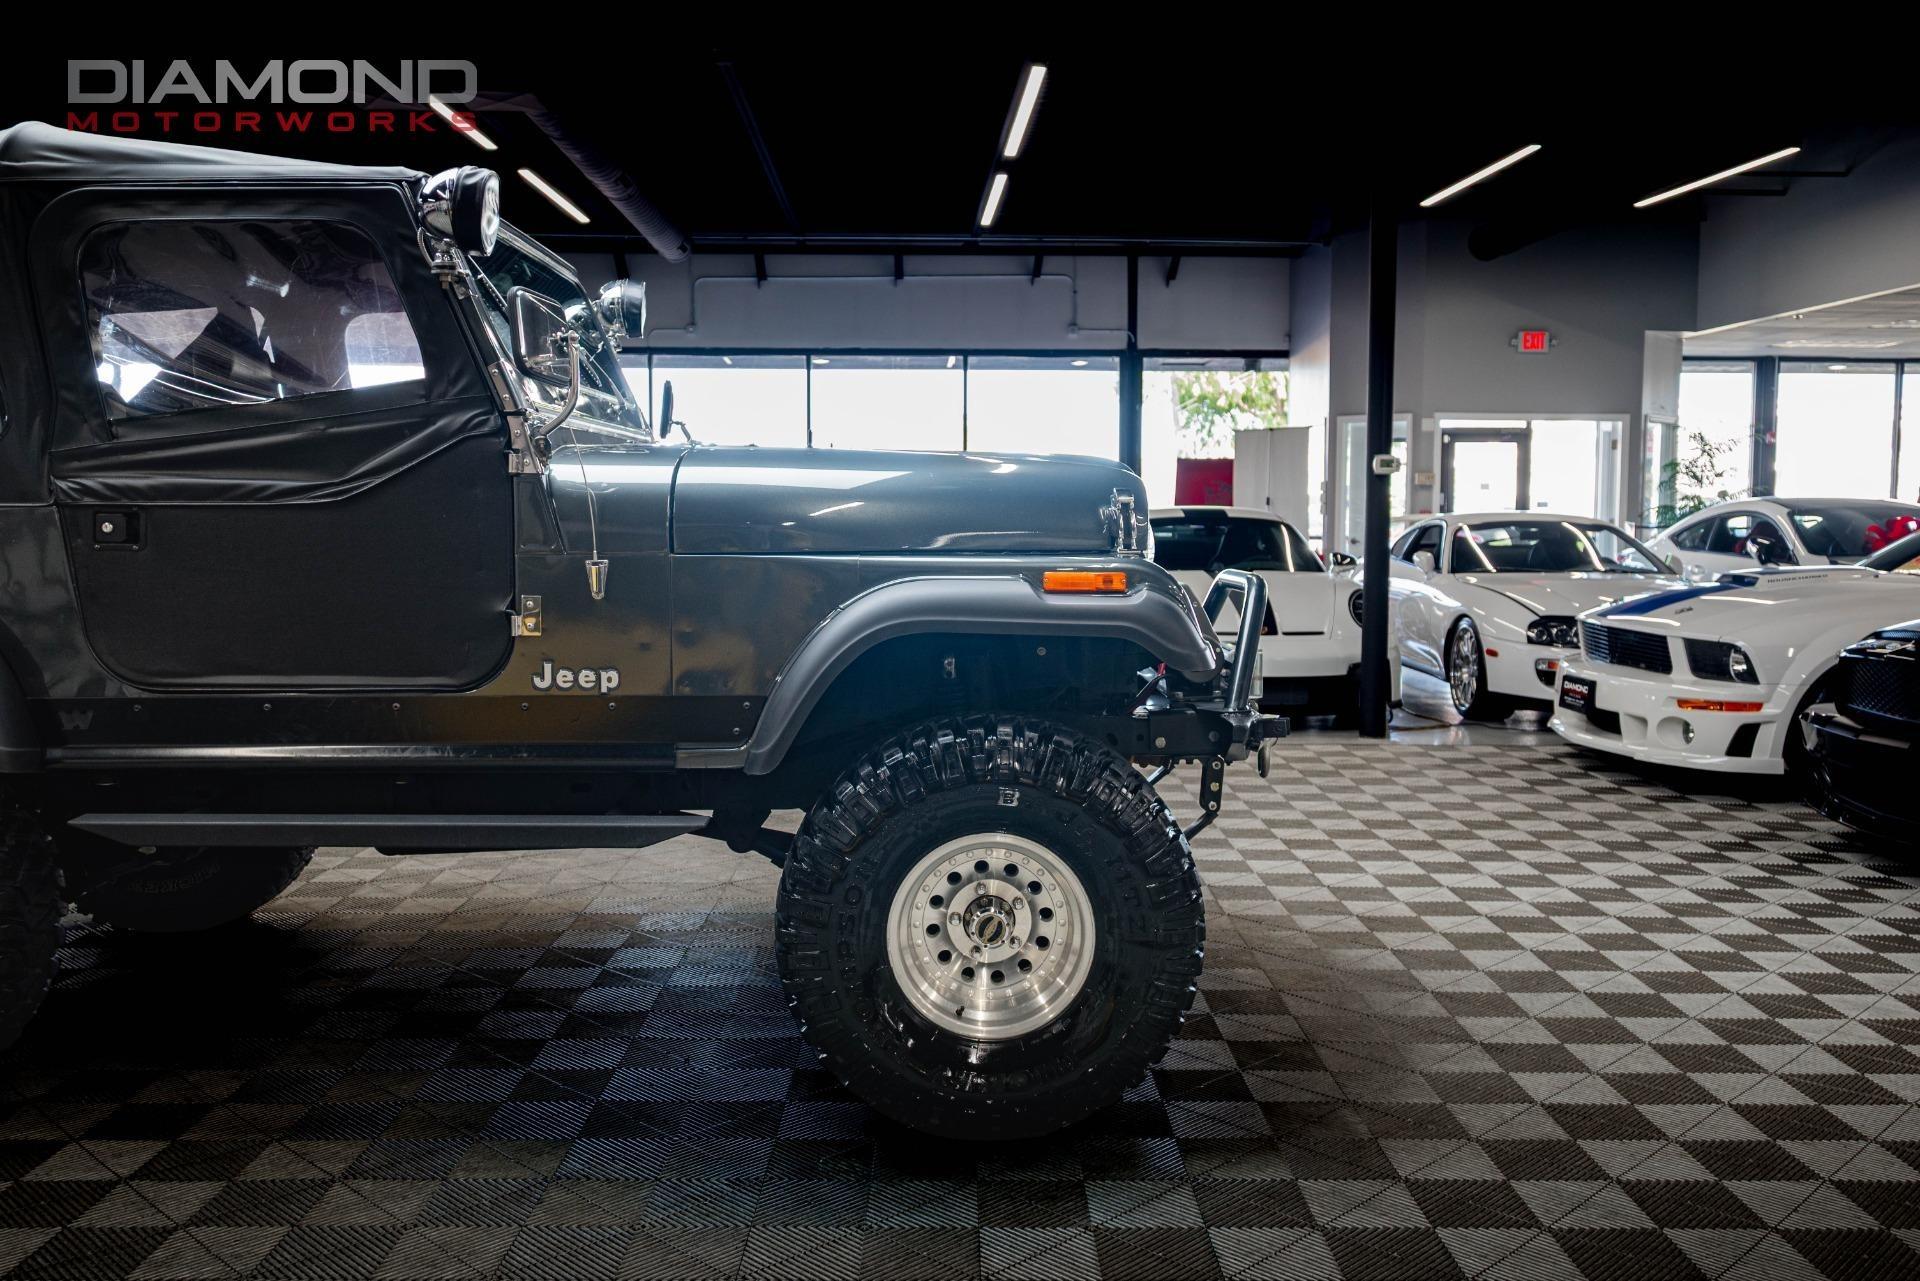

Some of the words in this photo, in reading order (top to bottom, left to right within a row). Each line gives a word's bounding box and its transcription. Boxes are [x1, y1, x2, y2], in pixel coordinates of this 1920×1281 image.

[1522, 331, 1546, 350] EXIT
[532, 659, 620, 695] Jeep
[1563, 681, 1589, 694] DIAMOND
